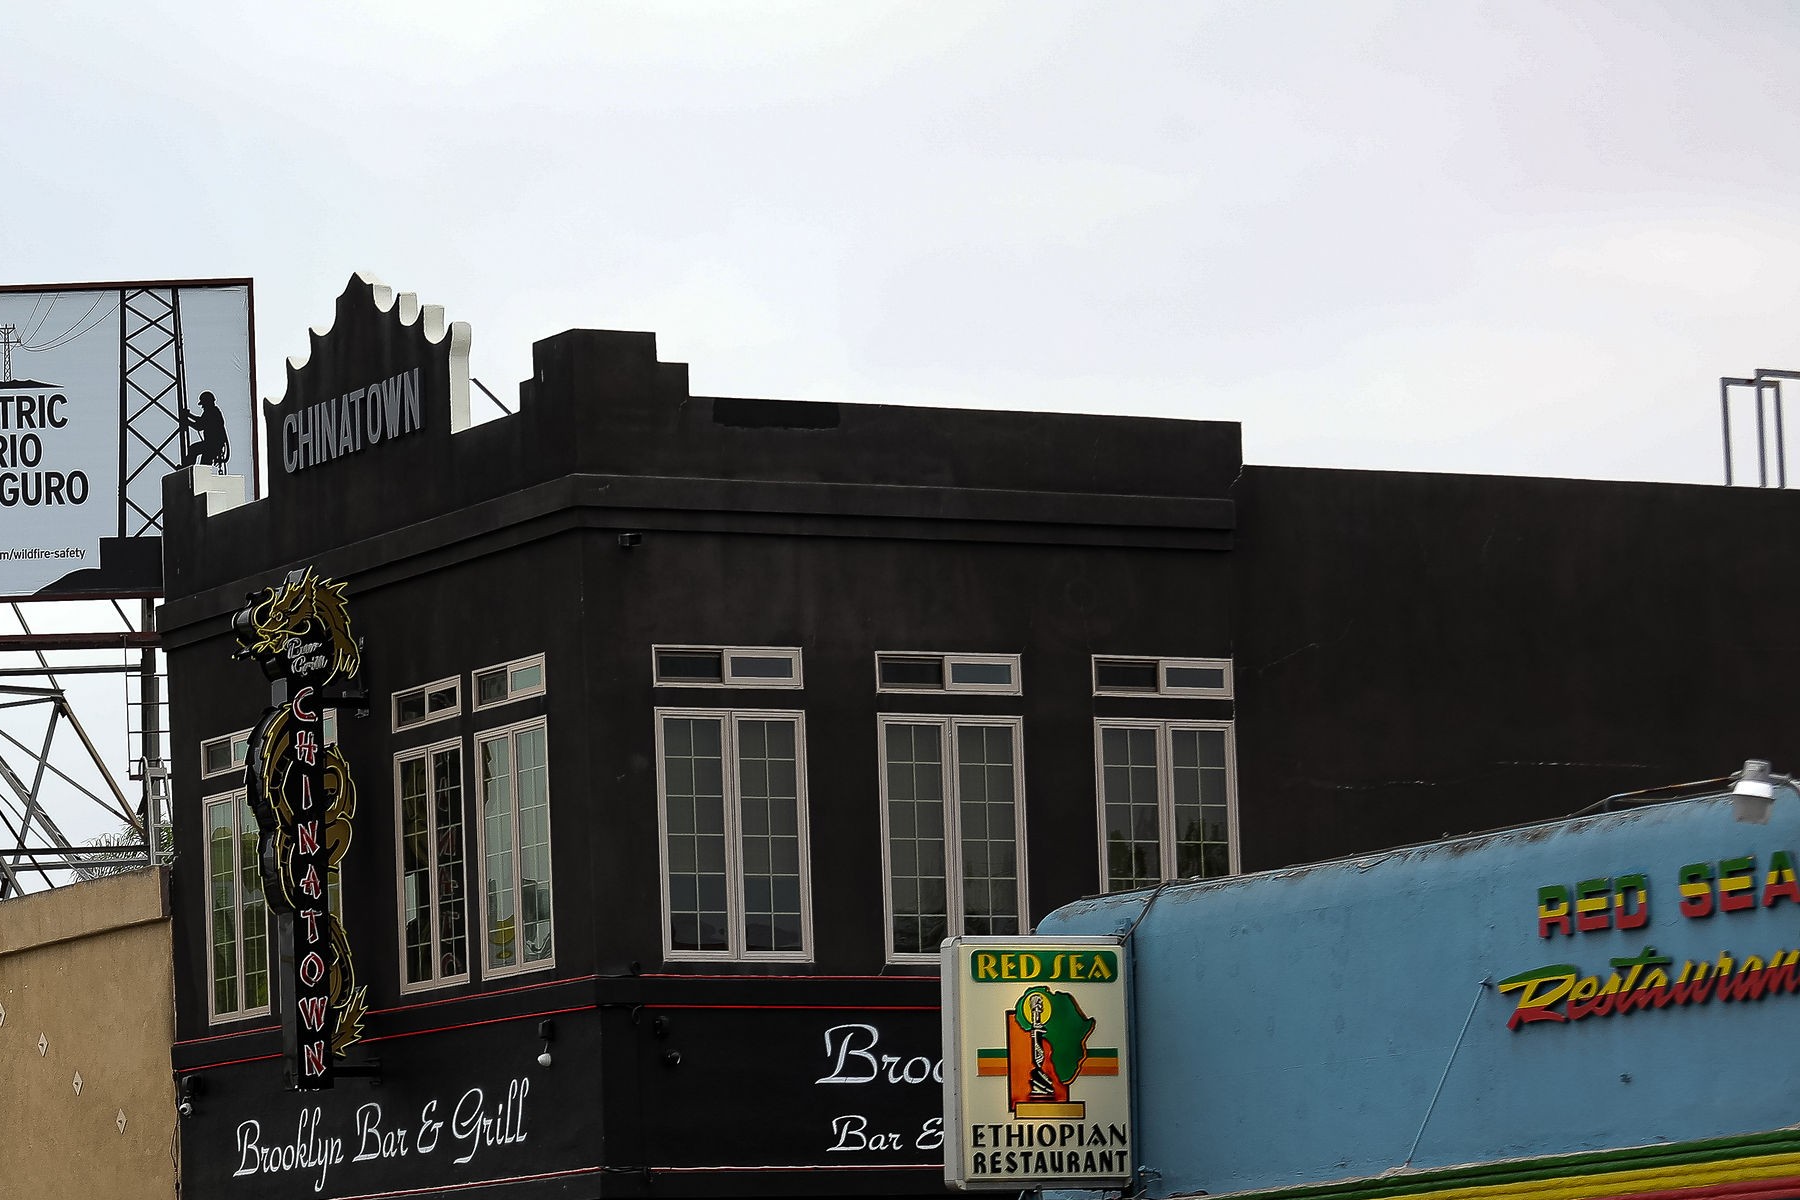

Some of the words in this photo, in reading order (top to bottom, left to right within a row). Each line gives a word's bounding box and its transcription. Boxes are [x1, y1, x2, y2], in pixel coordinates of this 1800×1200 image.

[282, 367, 422, 473] CHINATOWN
[292, 686, 327, 1077] CHINATOWN
[1537, 873, 1648, 938] RED
[1679, 851, 1800, 919] SEA
[977, 954, 1042, 980] RED
[1049, 953, 1112, 980] SEA
[233, 1106, 344, 1192] Brooklyn
[352, 1102, 408, 1162] Bar
[416, 1100, 444, 1154] &
[452, 1077, 530, 1164] Grill
[826, 1114, 903, 1152] Bar
[915, 1117, 944, 1150] &
[972, 1123, 1127, 1148] ETHIOPIAN
[973, 1150, 1128, 1175] RESTAURANT
